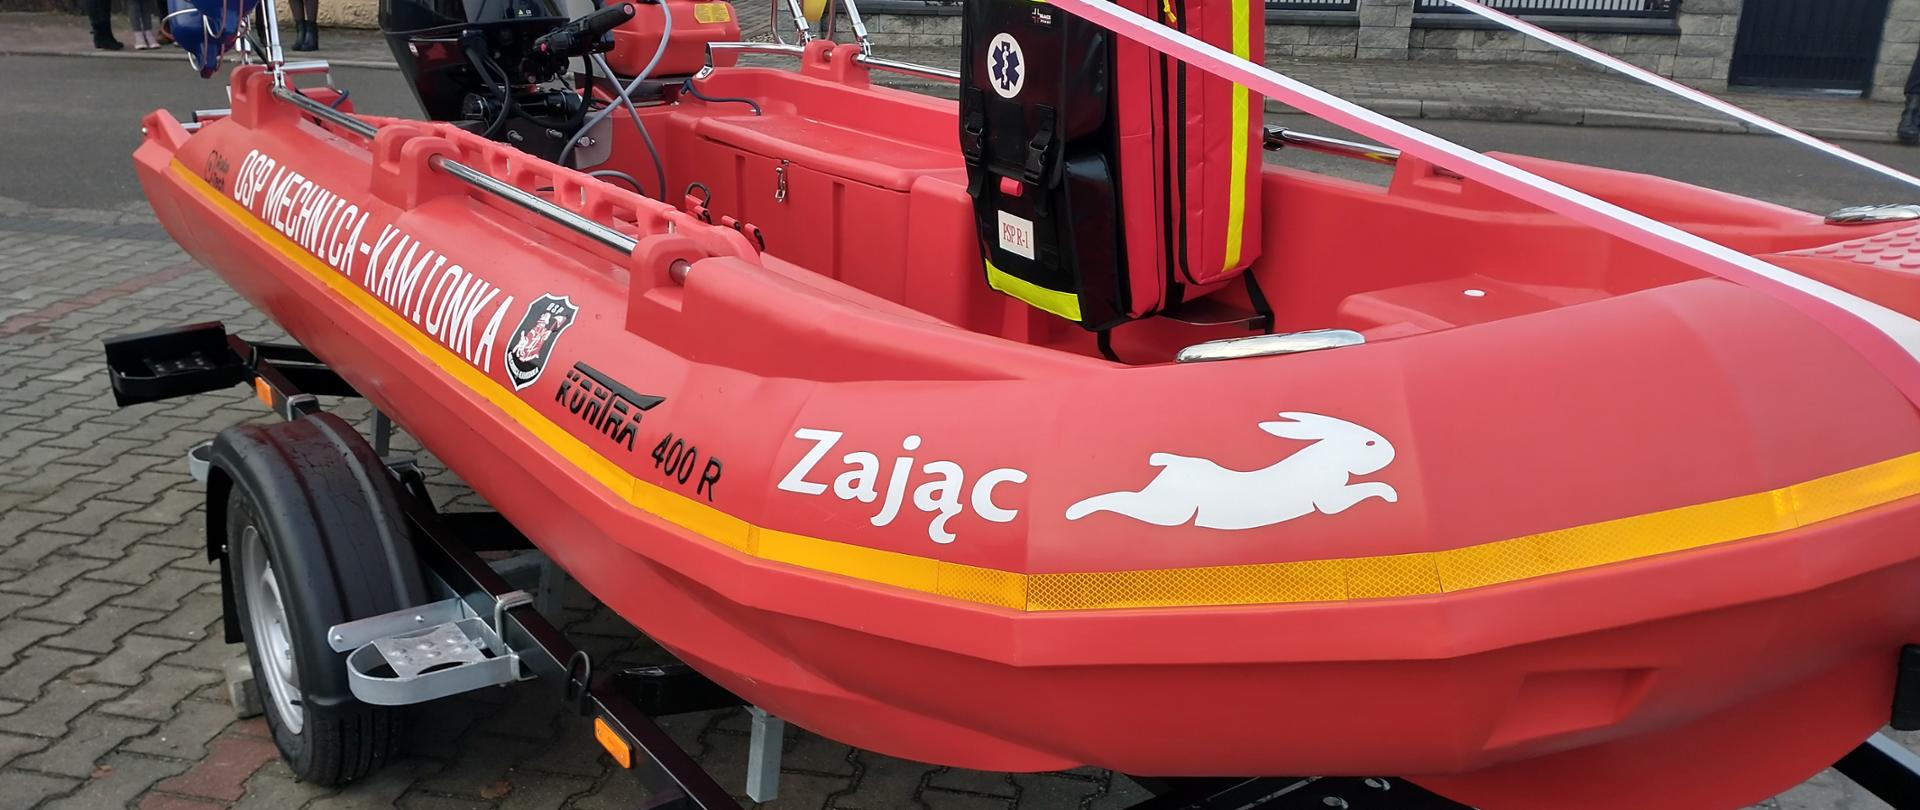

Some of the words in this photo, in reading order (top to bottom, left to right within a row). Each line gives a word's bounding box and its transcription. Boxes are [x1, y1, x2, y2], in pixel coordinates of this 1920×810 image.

[234, 149, 276, 210] OSP
[262, 165, 514, 373] MECHNICA-KAMIONKA
[1002, 222, 1015, 243] PSP
[1016, 227, 1029, 248] R-1
[546, 302, 565, 315] OSP
[651, 432, 697, 485] 400
[696, 456, 723, 502] R
[777, 428, 1028, 544] Zając
